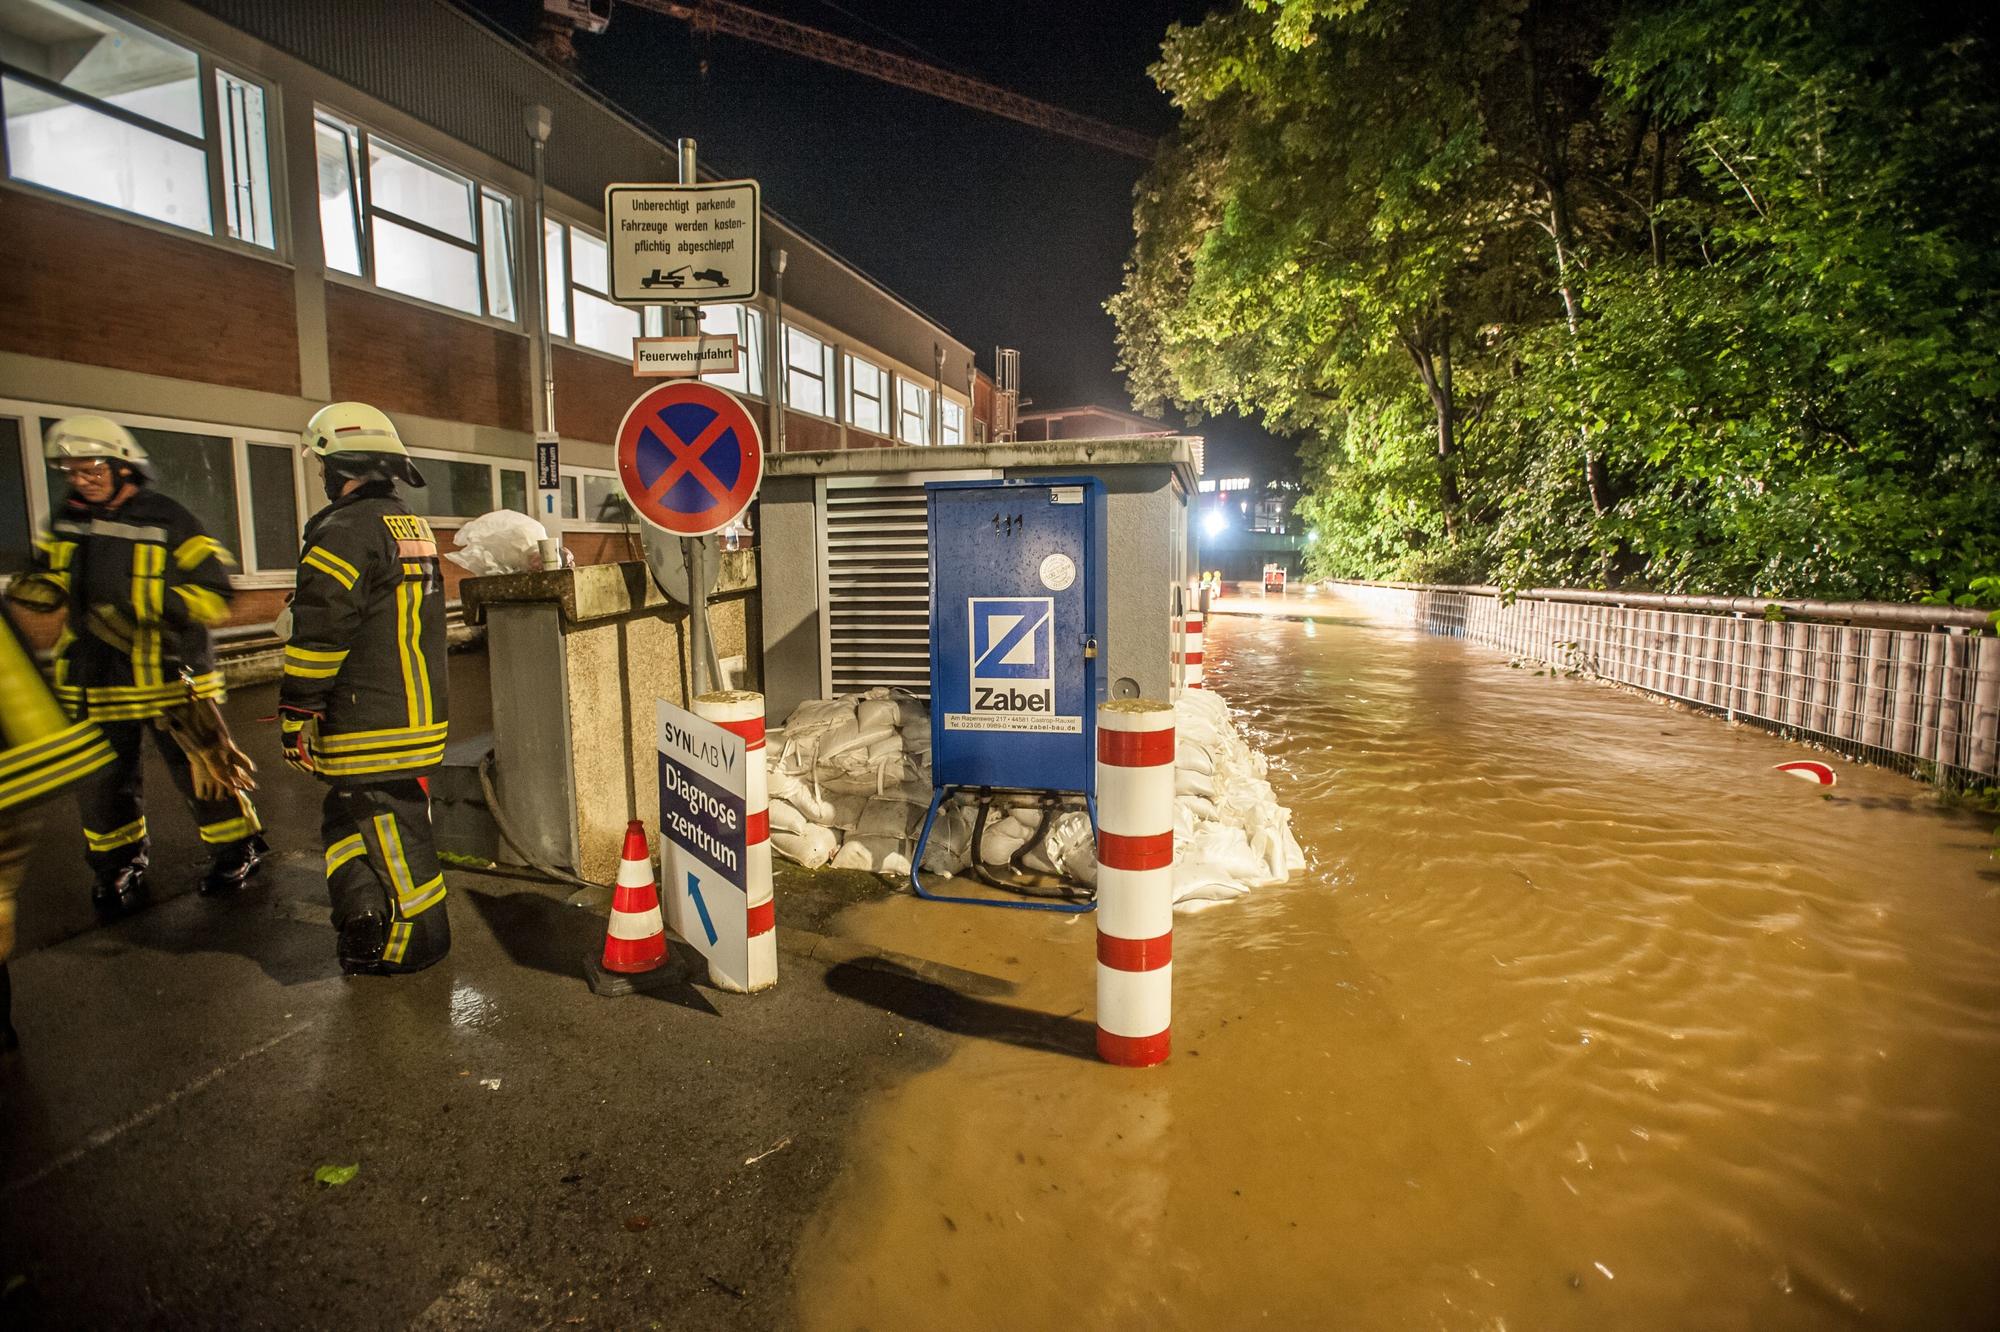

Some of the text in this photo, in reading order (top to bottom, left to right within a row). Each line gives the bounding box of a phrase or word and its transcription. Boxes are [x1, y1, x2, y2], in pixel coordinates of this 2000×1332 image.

[632, 198, 736, 214] Unberechtigt parkende
[621, 218, 747, 234] Fahrzeuge werden kosten-
[634, 239, 734, 255] pflichtig abgeschleppt
[540, 447, 549, 486] Diagnose
[992, 512, 1023, 537] 111
[975, 687, 1050, 712] Zabel
[665, 722, 719, 768] SYNLAB
[665, 763, 737, 830] Diagnose
[666, 811, 737, 872] -zentrum
